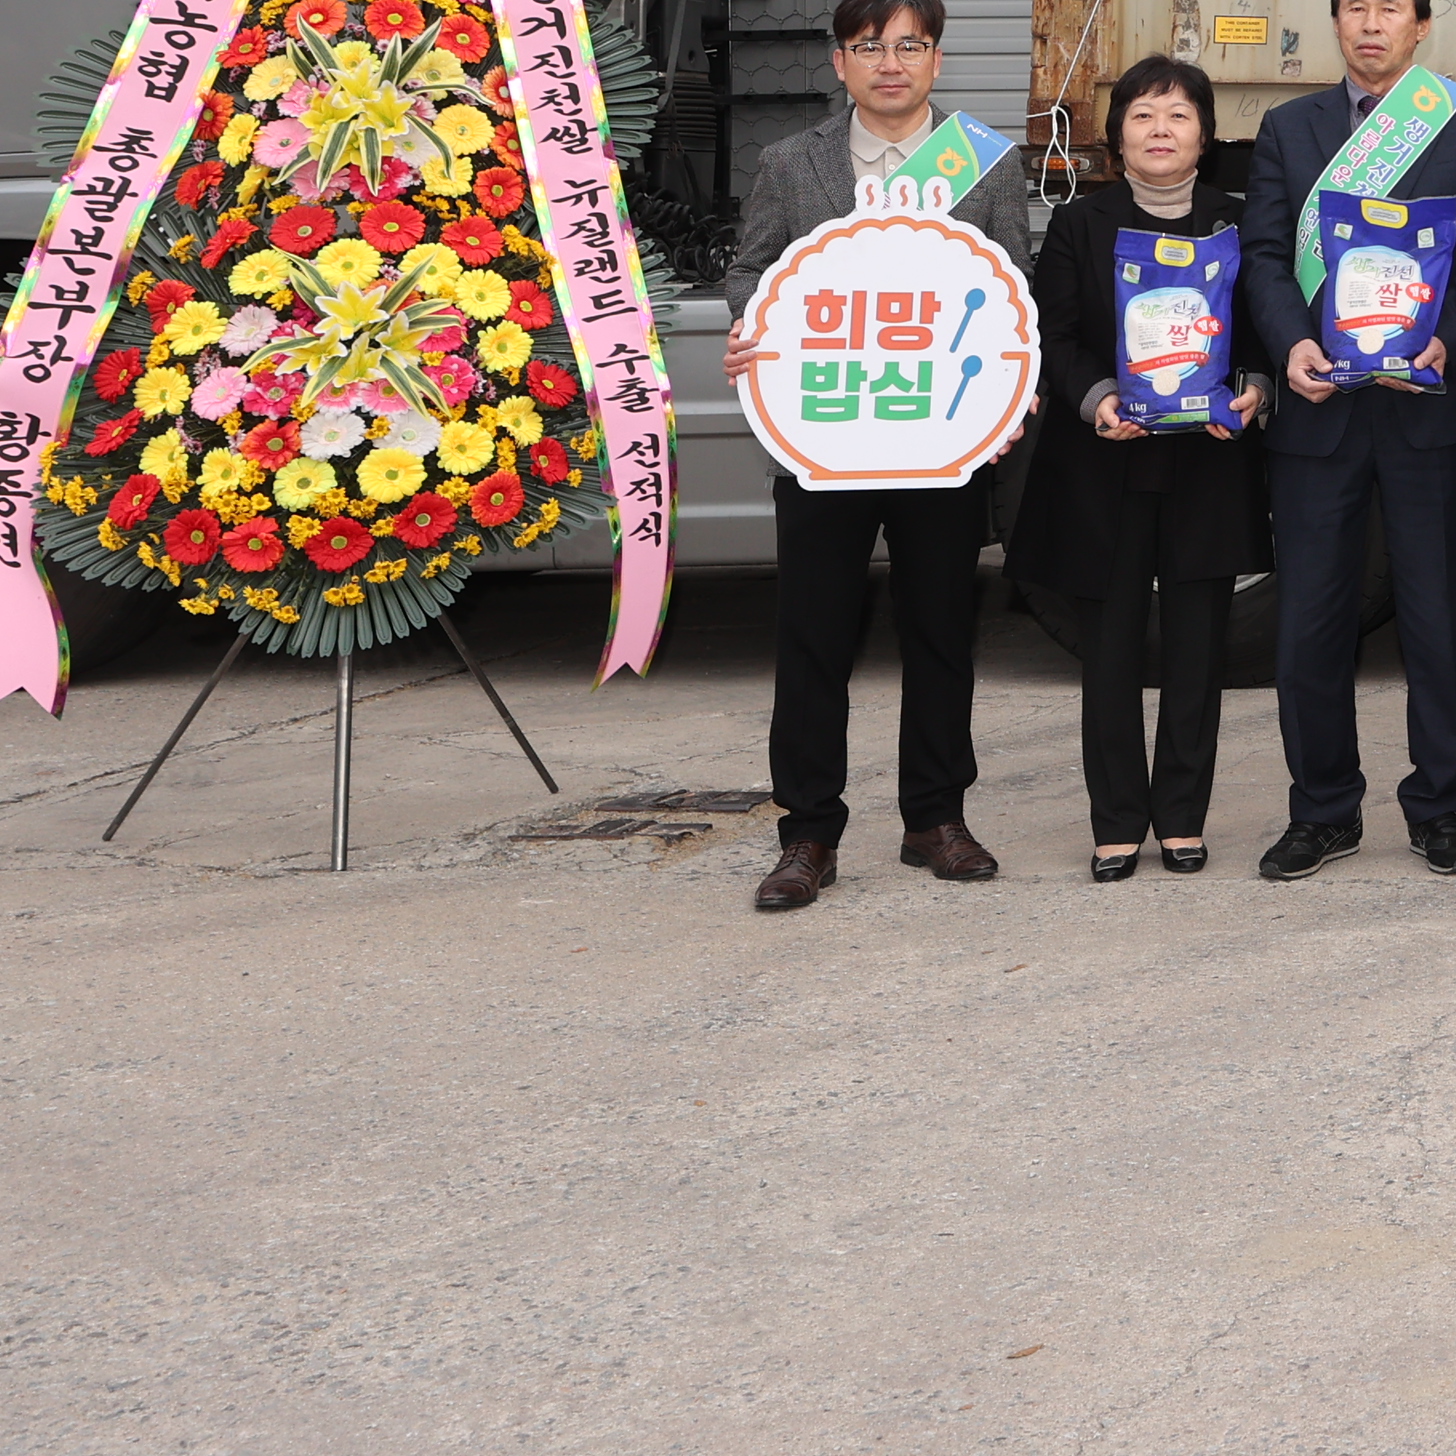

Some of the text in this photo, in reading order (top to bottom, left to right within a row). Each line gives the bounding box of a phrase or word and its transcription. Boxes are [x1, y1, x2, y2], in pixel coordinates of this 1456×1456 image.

[966, 123, 989, 140] NH
[1330, 113, 1397, 188] 아름다운
[11, 125, 159, 384] 총괄본부장
[550, 178, 640, 325] 뉴질랜드
[800, 288, 942, 351] 희망
[1374, 283, 1403, 308] 쌀
[1166, 323, 1194, 348] 쌀
[594, 343, 661, 414] 수출
[800, 360, 934, 423] 밥심
[613, 432, 668, 548] 선적식
